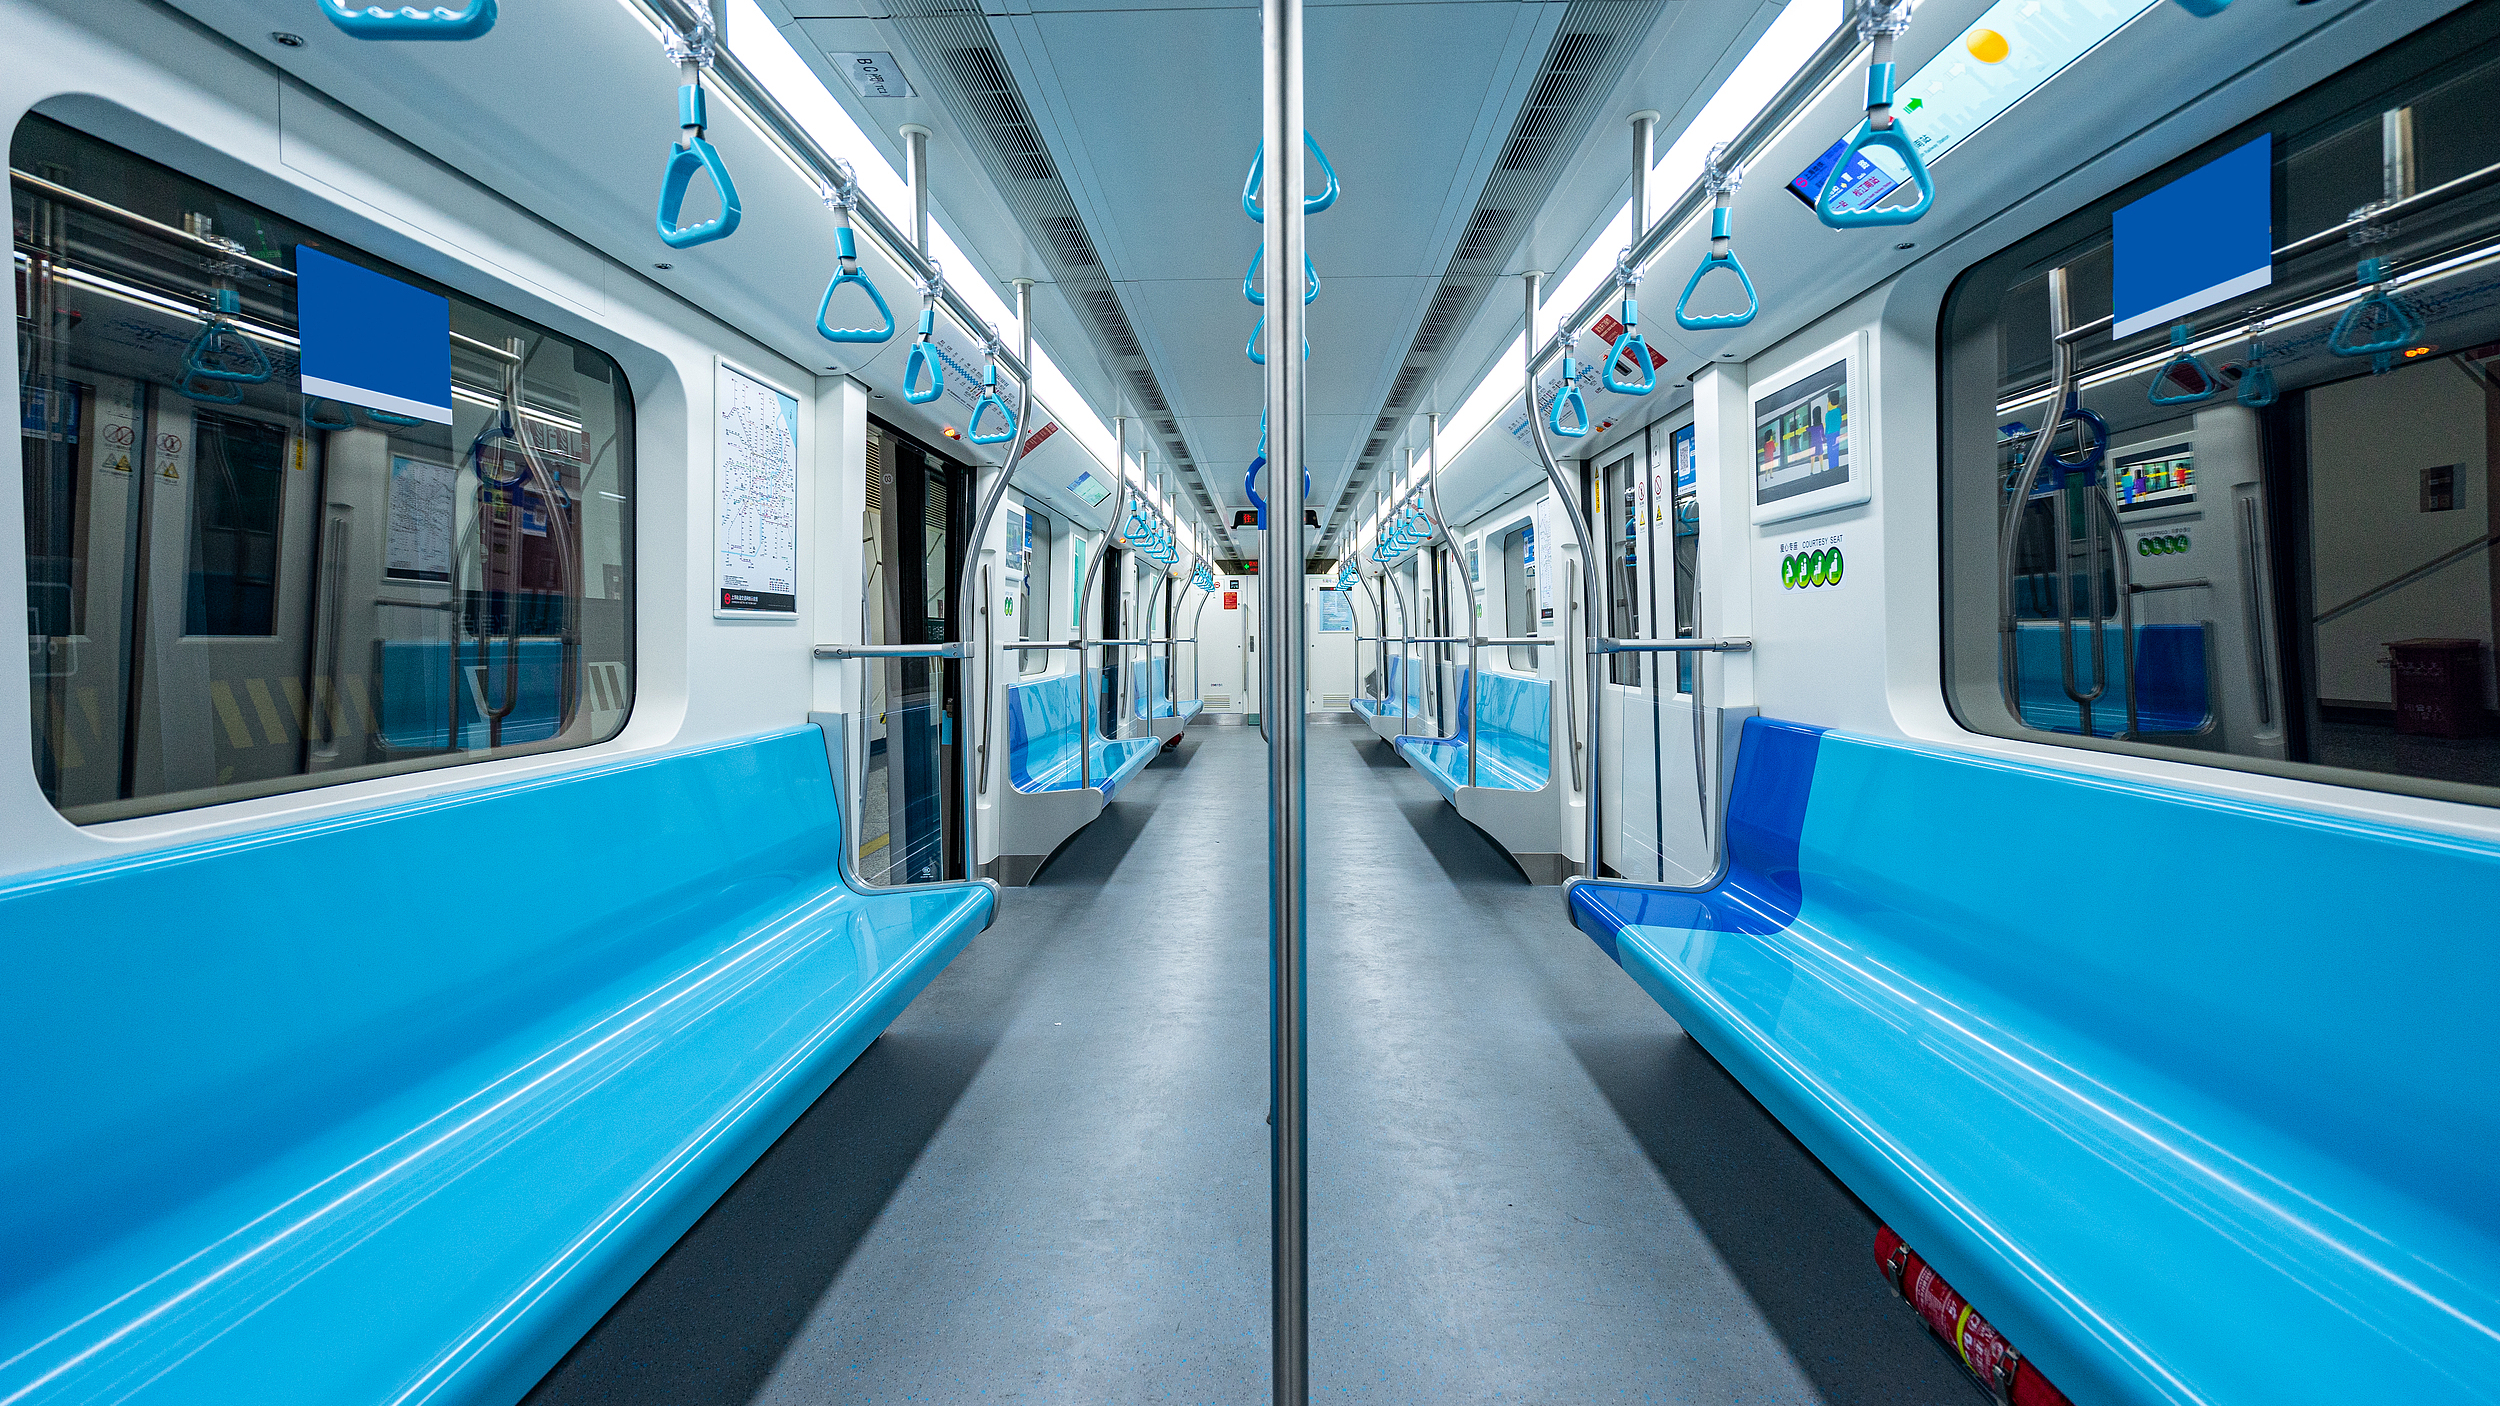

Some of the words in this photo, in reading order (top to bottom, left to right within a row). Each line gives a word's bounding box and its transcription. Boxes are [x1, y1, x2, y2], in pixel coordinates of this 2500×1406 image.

[1852, 176, 1881, 197] 松江南站
[1802, 537, 1829, 549] COURTESY
[1830, 534, 1844, 544] SEAT
